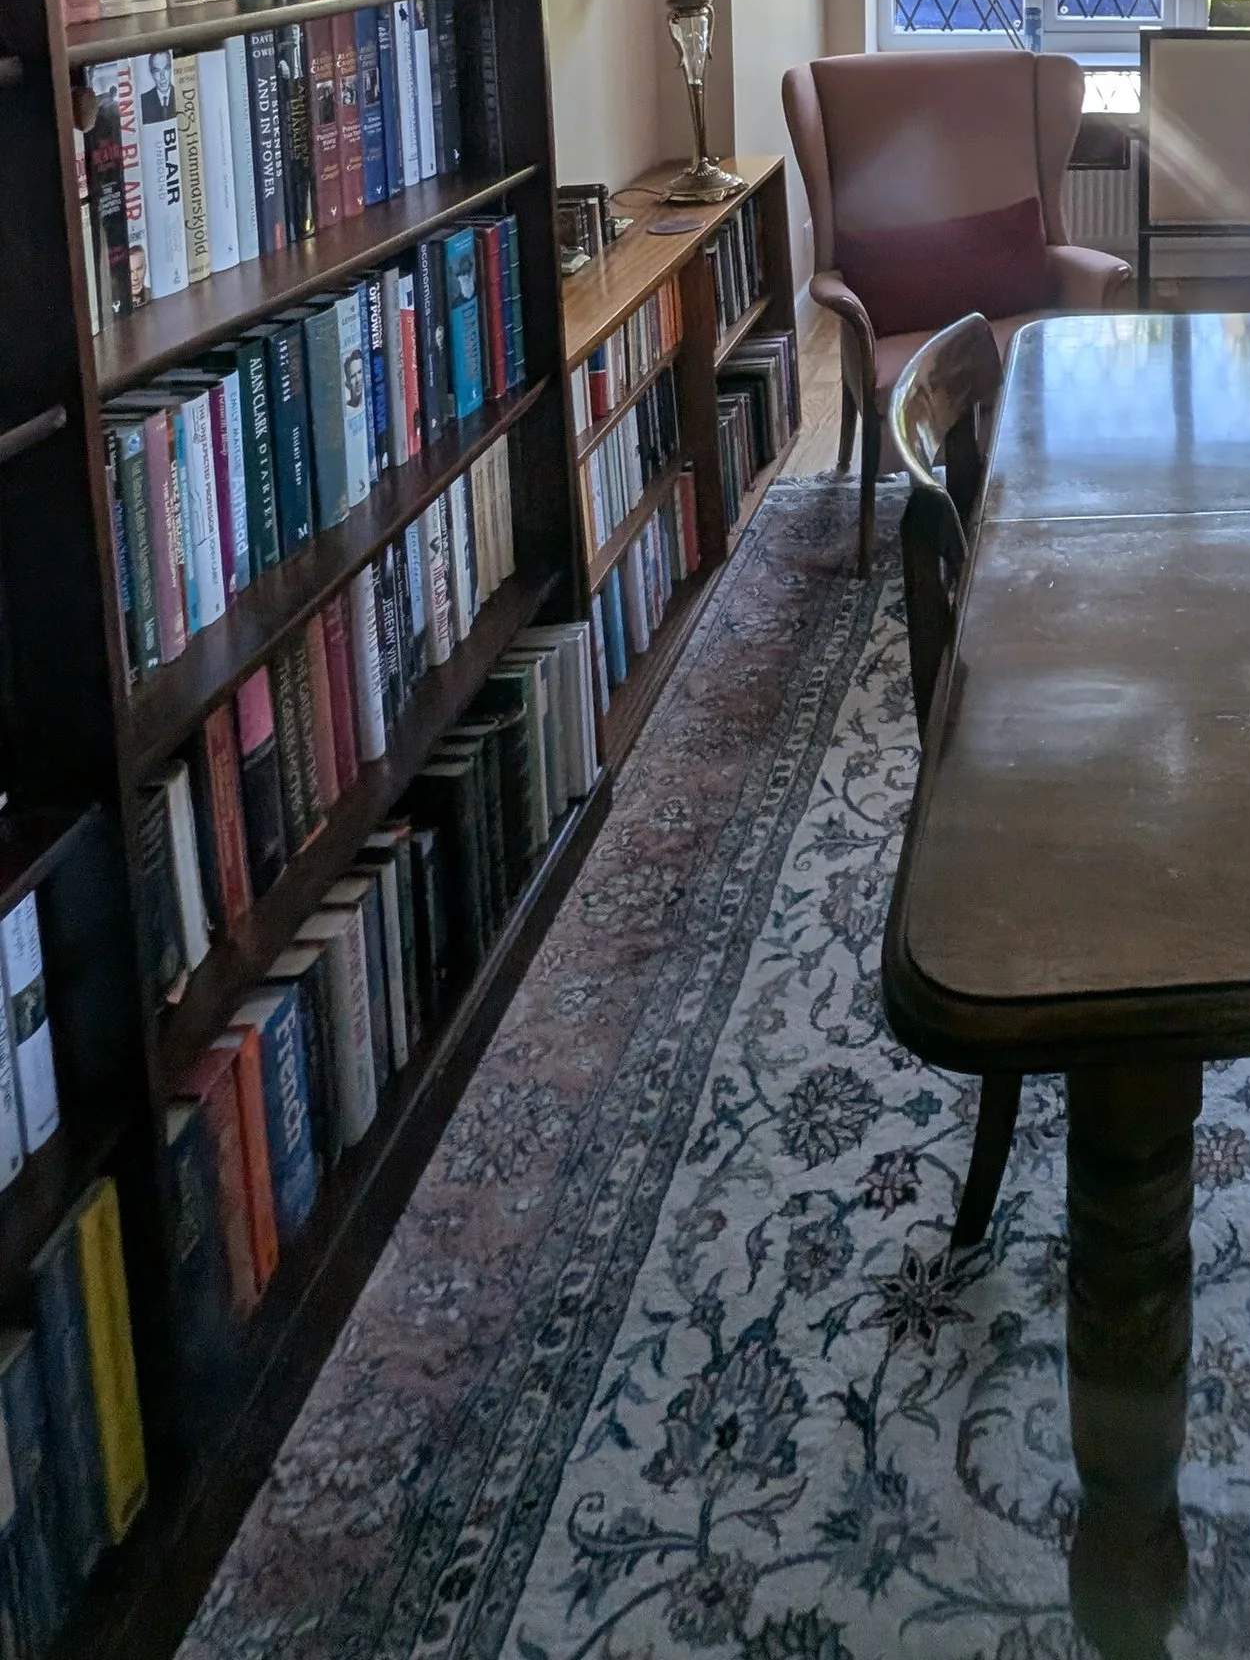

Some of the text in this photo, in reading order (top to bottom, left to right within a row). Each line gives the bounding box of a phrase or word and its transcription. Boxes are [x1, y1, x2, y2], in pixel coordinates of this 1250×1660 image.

[177, 90, 196, 132] Dag
[257, 78, 276, 198] AND IN POWER
[270, 74, 283, 178] IN SICKNESS
[117, 66, 142, 221] TONY BLAIR
[154, 142, 166, 200] UNBOUND
[164, 128, 180, 206] BLAIR
[420, 244, 431, 317] economics
[370, 299, 382, 350] POWER
[230, 392, 238, 424] EMILY
[200, 423, 211, 480] UNEXPECTED
[250, 356, 274, 530] ALAN CLARK DIARIES
[205, 482, 215, 533] PROFESSOR
[232, 476, 248, 557] Airhead
[433, 564, 445, 586] THE
[434, 586, 447, 610] LAST
[382, 597, 396, 641] JEREMY
[436, 611, 450, 641] WALTZ
[276, 1003, 306, 1154] French
